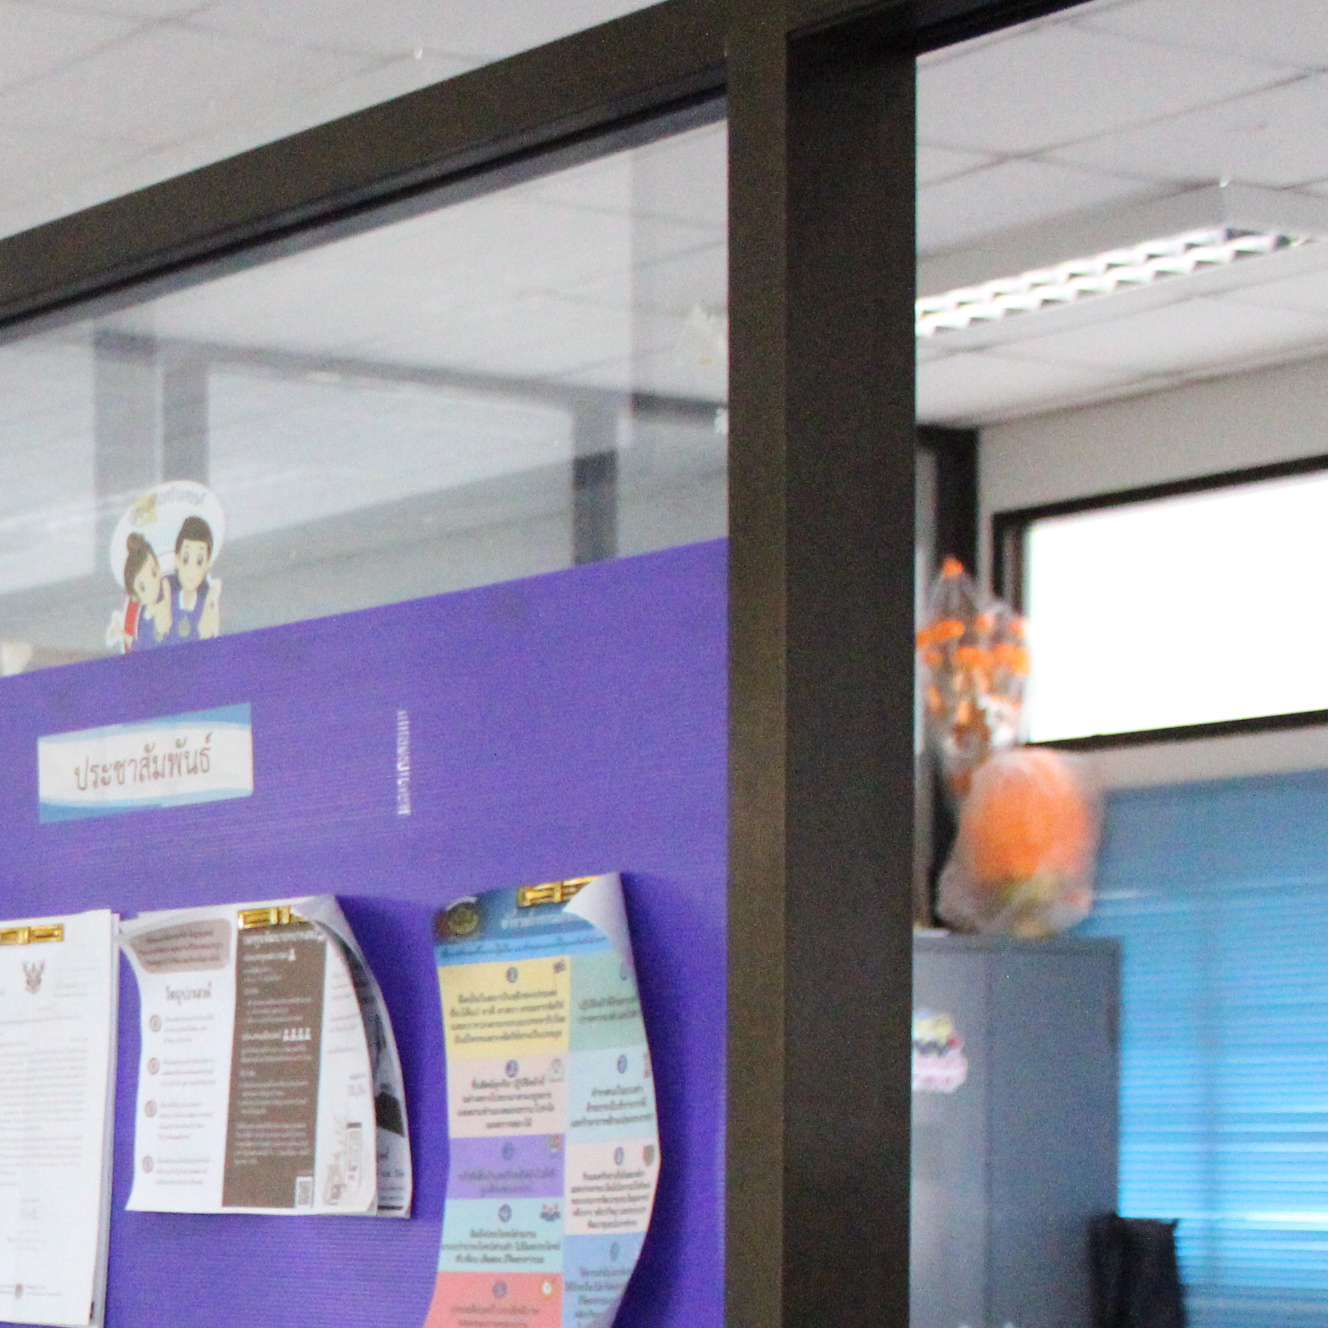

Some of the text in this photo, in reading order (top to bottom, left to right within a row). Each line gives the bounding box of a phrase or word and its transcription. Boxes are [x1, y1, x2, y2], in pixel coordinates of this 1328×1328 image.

[74, 732, 213, 792] ประชาสัมพันธ์
